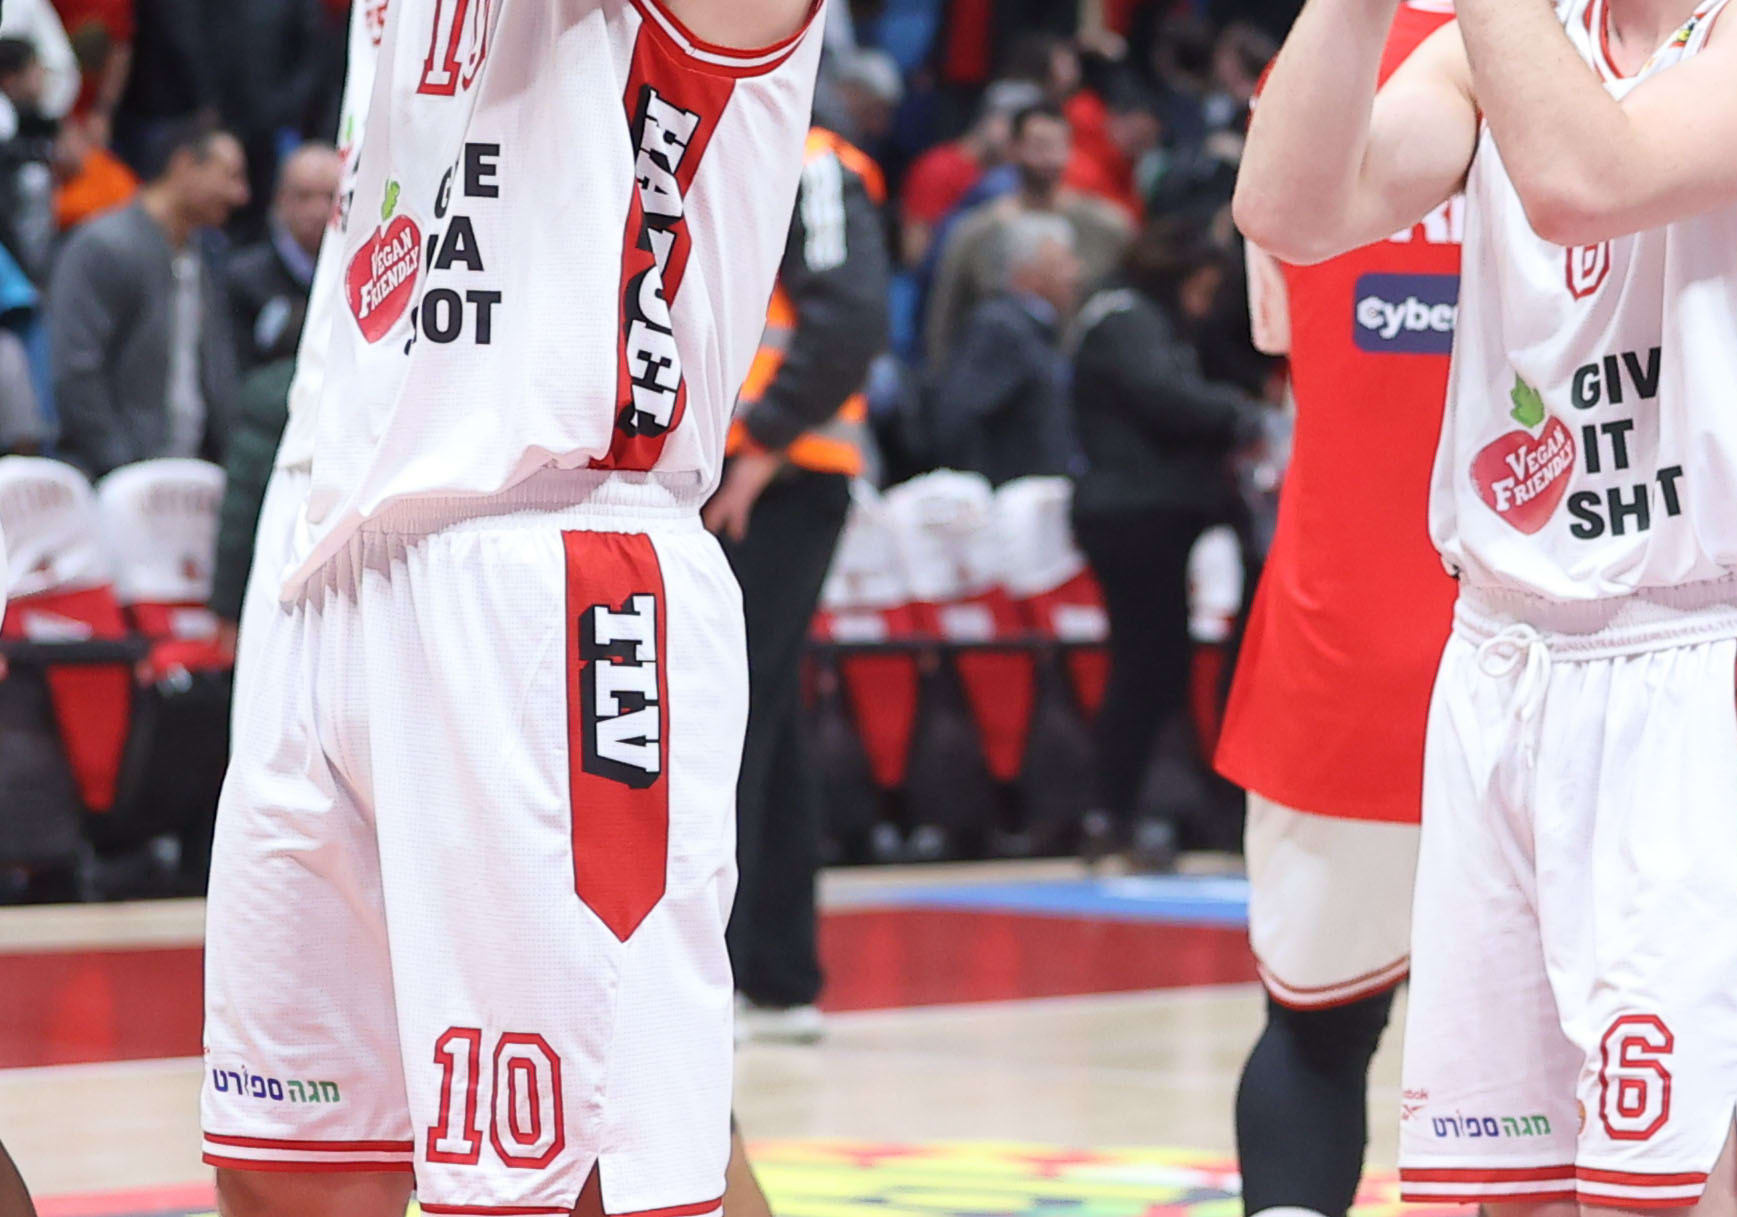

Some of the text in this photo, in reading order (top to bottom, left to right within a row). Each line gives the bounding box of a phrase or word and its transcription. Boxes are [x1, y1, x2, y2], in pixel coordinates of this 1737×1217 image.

[358, 245, 420, 320] FRIENDLY
[371, 226, 414, 282] VEGAN
[1570, 346, 1662, 410] GIV
[1490, 439, 1575, 513] FRIENDLY
[1504, 424, 1567, 482] VEGAN
[1581, 417, 1635, 475] IT
[1566, 464, 1684, 541] SHT
[588, 593, 662, 780] TLV
[425, 1025, 566, 1170] 10
[1599, 1013, 1675, 1142] 6
